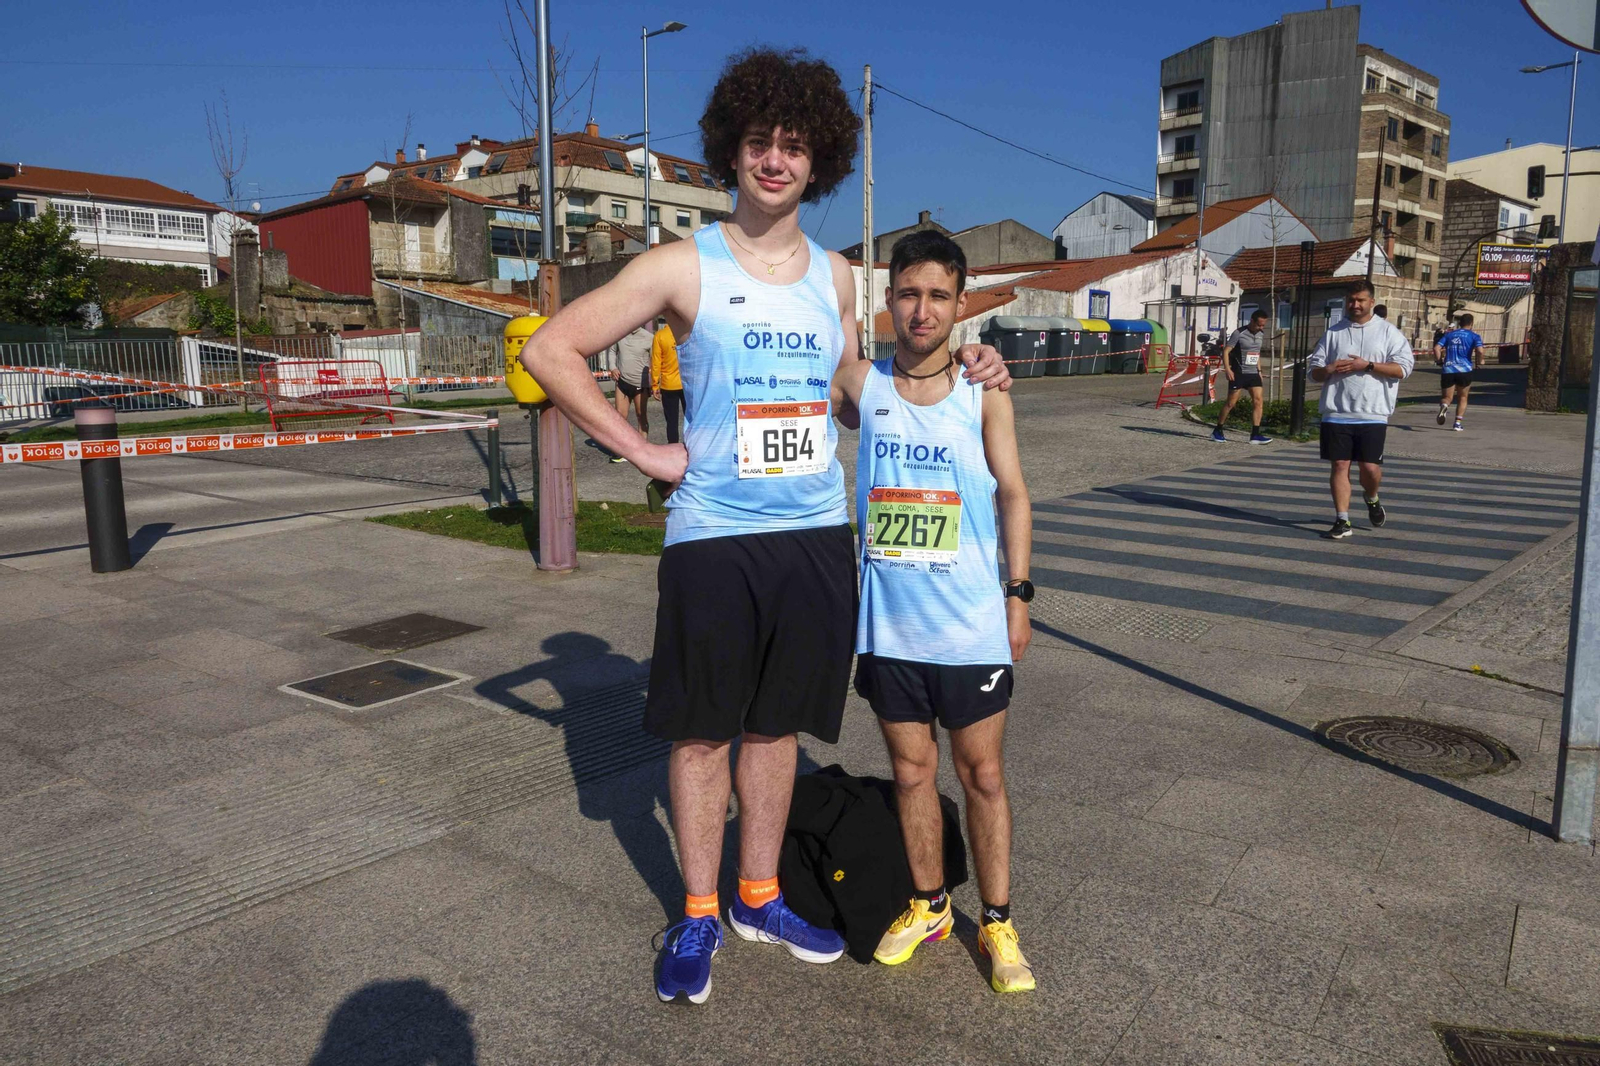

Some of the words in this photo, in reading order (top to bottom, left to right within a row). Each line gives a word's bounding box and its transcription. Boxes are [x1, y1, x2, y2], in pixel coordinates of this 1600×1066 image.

[780, 419, 799, 427] SESE
[763, 428, 814, 463] 664
[880, 504, 894, 512] OLA
[898, 505, 921, 513] COMA,
[925, 506, 944, 514] SESE
[876, 512, 948, 549] 2267
